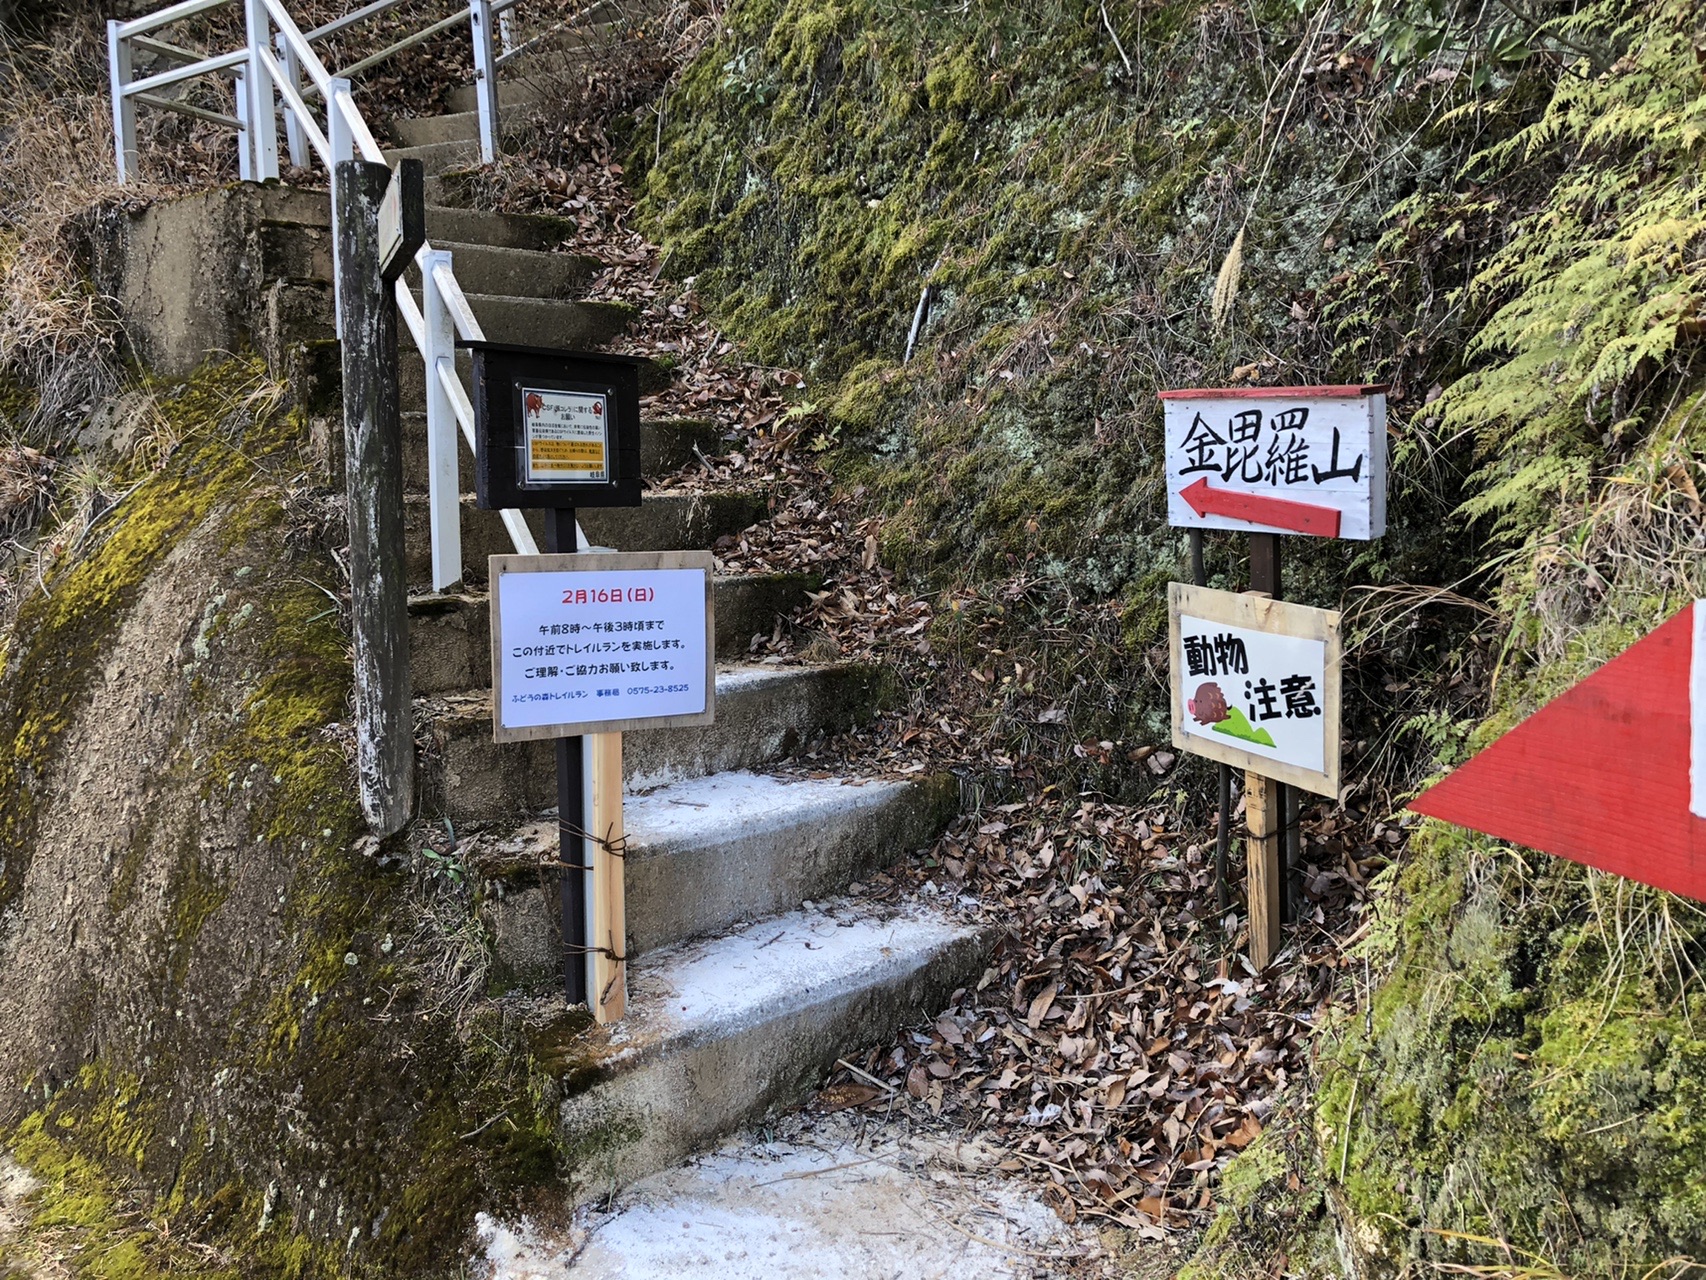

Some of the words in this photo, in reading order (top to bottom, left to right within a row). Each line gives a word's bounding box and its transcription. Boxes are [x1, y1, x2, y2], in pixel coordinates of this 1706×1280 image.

[1178, 407, 1363, 486] 金毘羅山
[512, 639, 686, 658] この付近でトレイルランを実施します。
[1183, 633, 1249, 676] 動物
[524, 660, 675, 679] ご理解・ご協力お願い致します。
[511, 690, 589, 703] ふどうの森トレイルラン
[627, 683, 690, 695] 0575-23-8525
[1244, 674, 1321, 722] 注意
